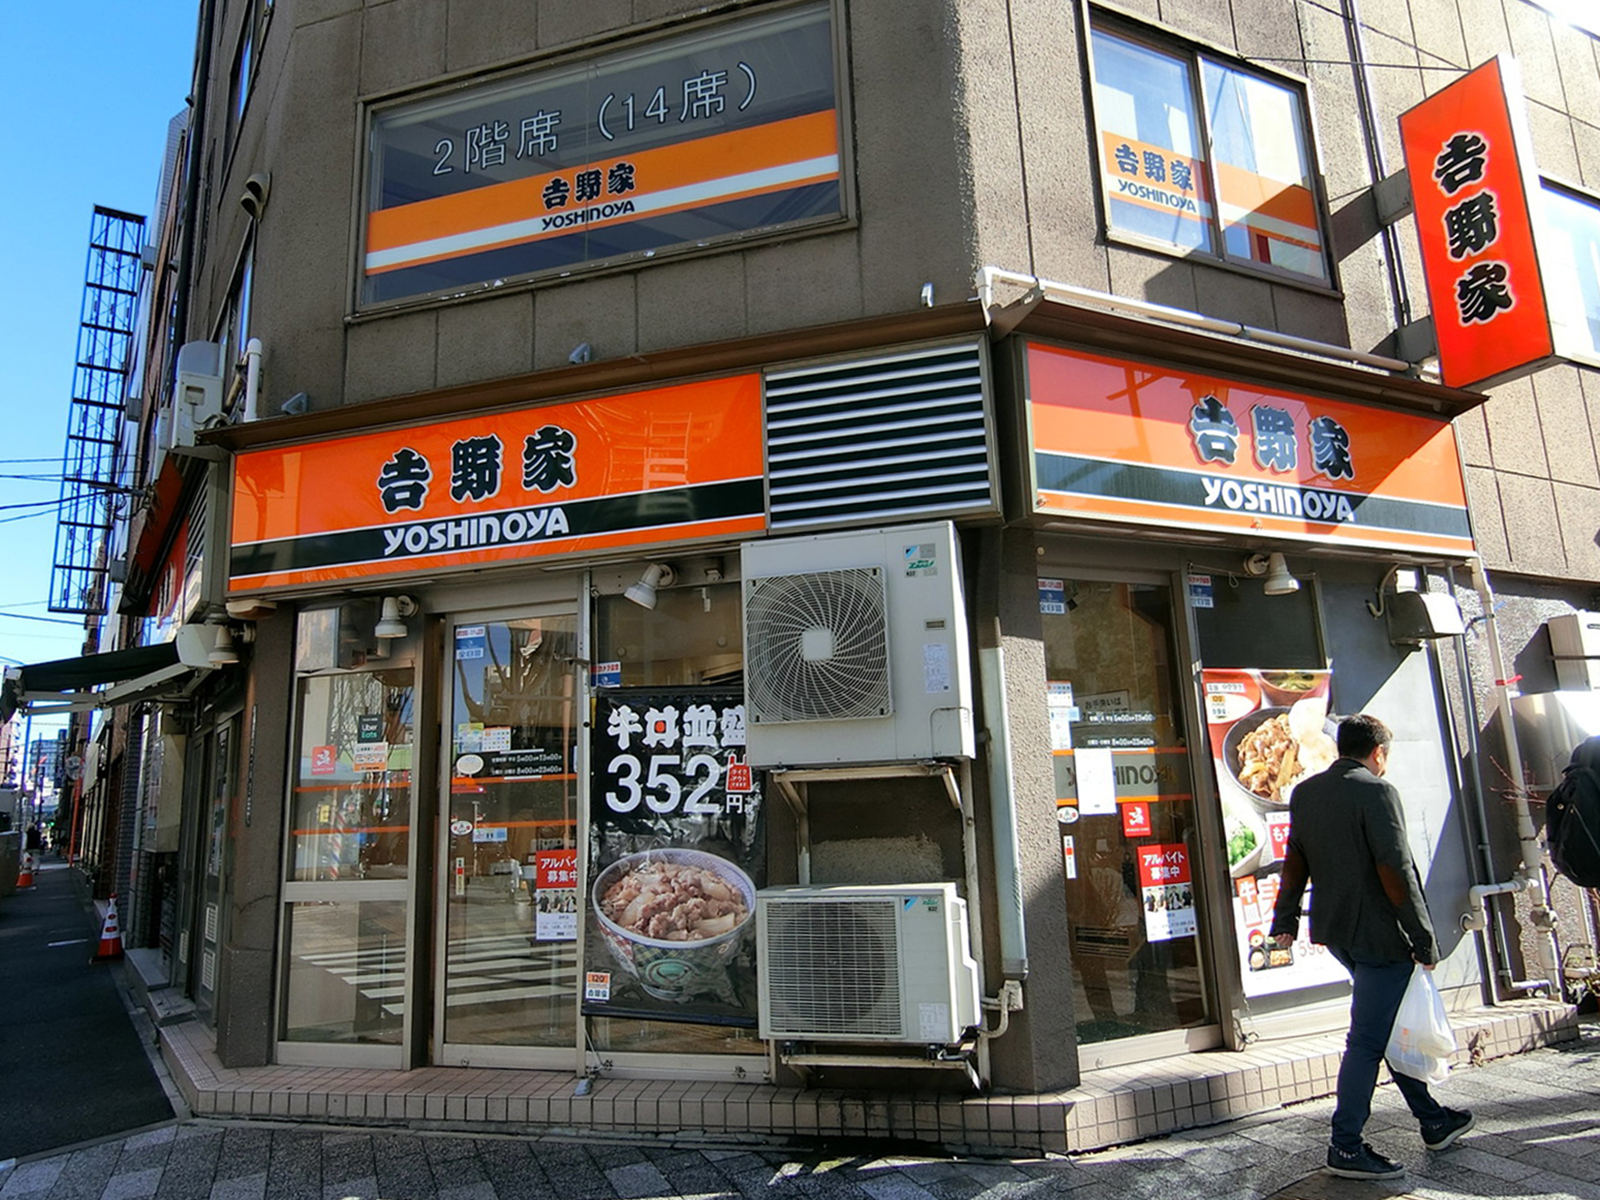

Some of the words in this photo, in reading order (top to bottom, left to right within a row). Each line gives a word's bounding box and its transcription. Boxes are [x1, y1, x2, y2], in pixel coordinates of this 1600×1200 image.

[541, 162, 636, 211] 吉野家
[1114, 143, 1194, 192] 吉野家
[541, 199, 636, 231] YOSHINOYA
[1117, 178, 1197, 215] YOSHINOYA
[1433, 132, 1516, 326] 吉野家
[1189, 394, 1356, 481] 吉野家
[377, 425, 578, 514] 吉野家
[1201, 477, 1355, 522] YOSHINOYA
[383, 506, 569, 556] YOSHINOYA
[1142, 851, 1185, 867] アルバイト
[1150, 866, 1181, 880] 募集中
